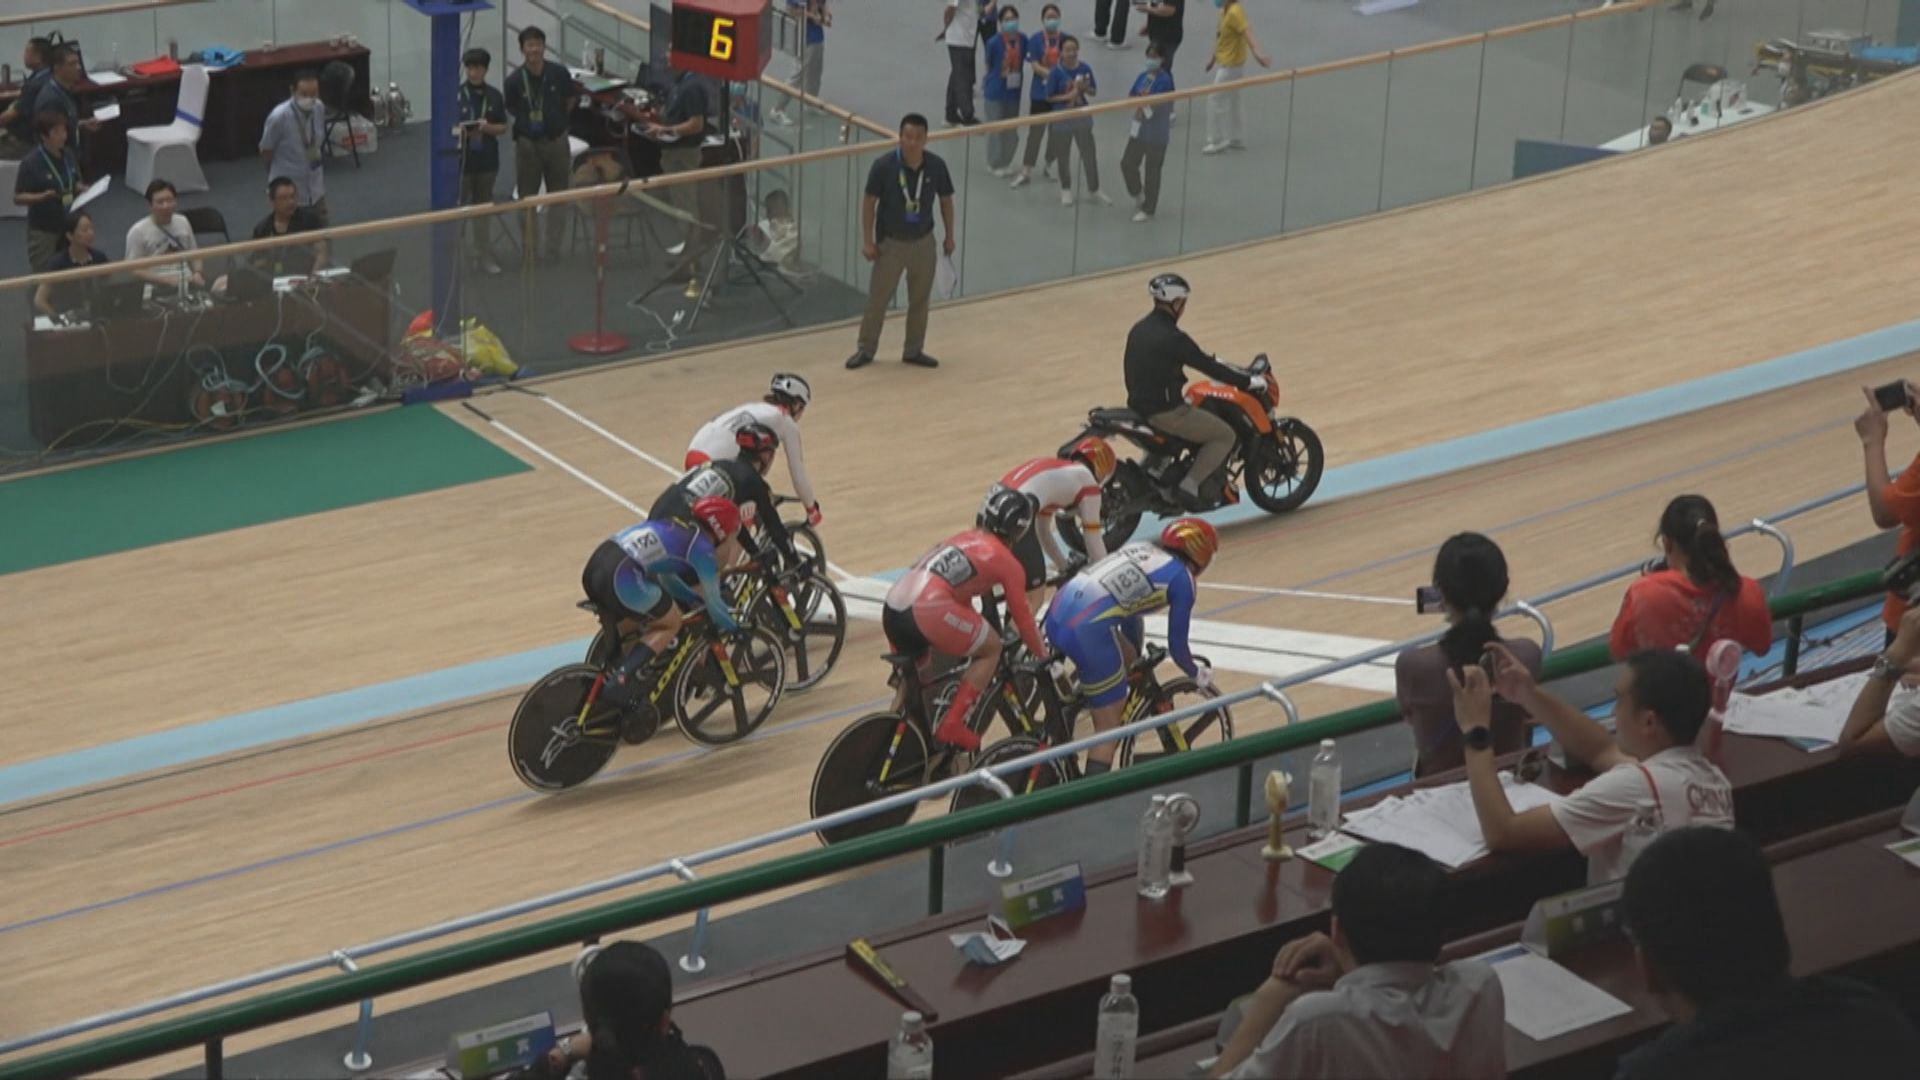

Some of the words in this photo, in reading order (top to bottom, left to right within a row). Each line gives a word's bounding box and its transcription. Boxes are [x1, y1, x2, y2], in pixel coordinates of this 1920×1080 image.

[710, 17, 734, 60] 6
[1114, 568, 1141, 595] 183
[649, 632, 695, 704] LOOK
